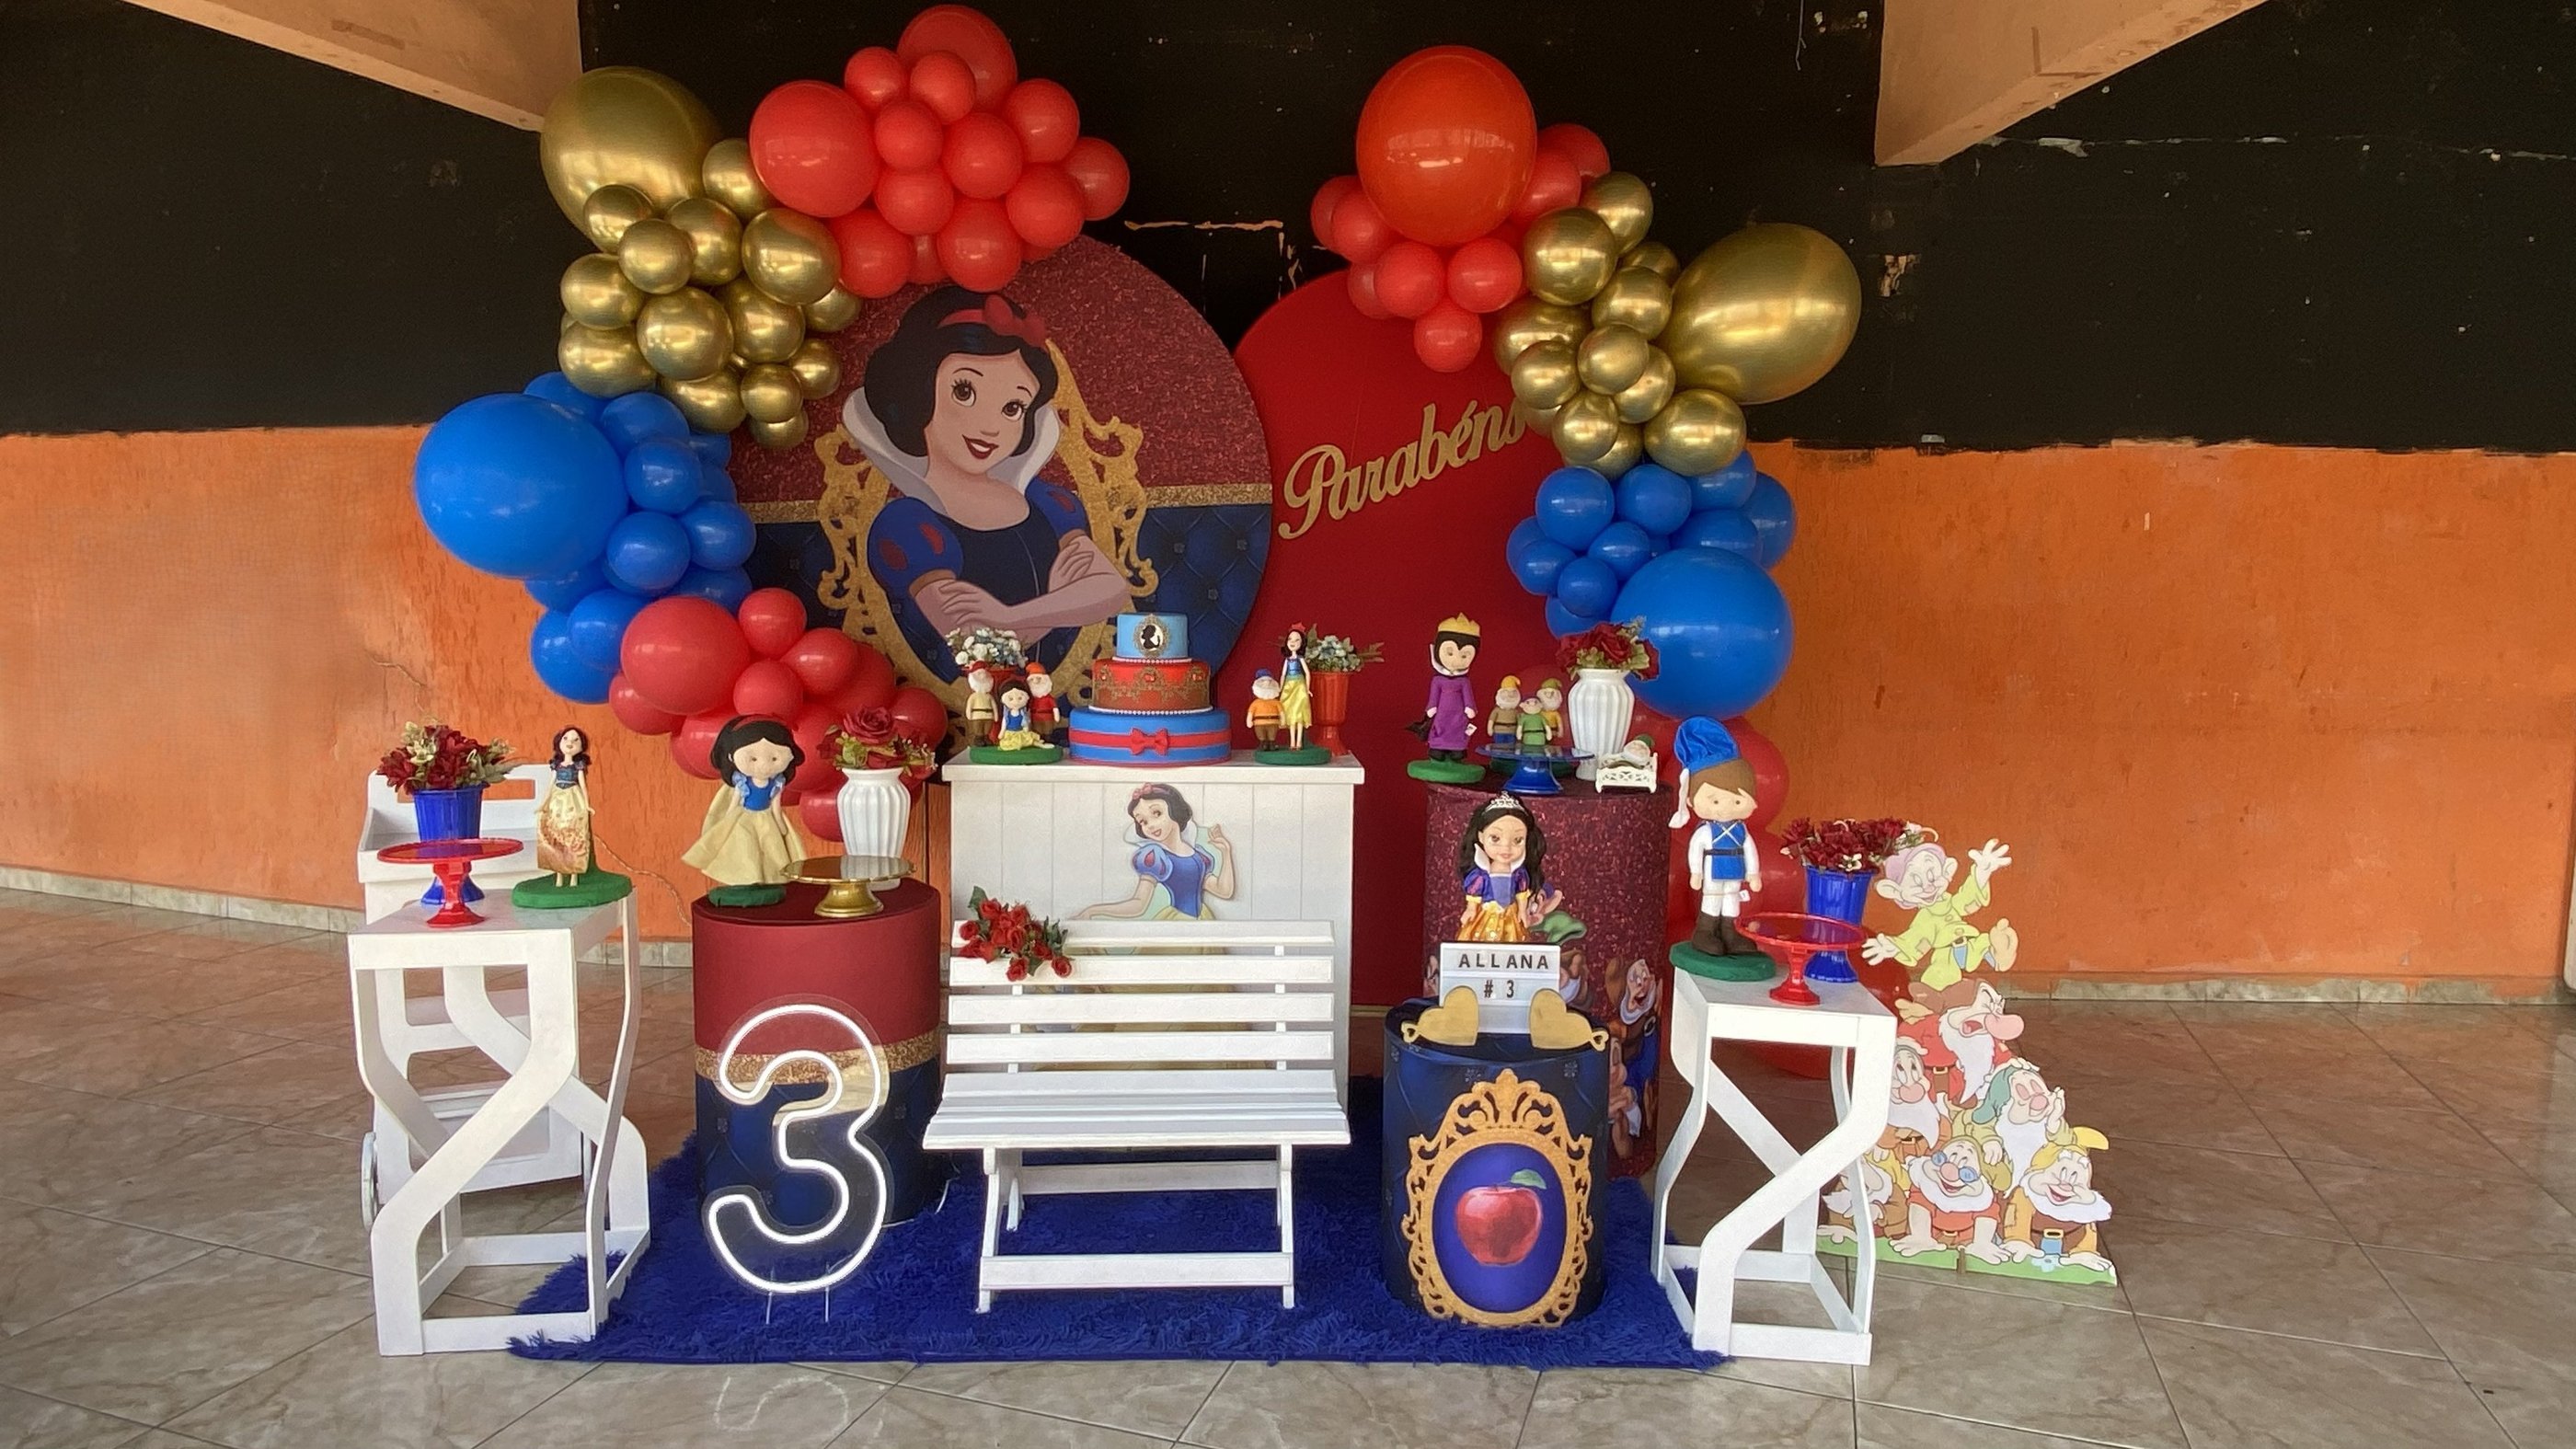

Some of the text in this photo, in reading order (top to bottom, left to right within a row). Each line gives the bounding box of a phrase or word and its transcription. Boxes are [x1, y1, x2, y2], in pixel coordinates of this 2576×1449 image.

[1279, 398, 1527, 539] Parabéns
[1459, 953, 1549, 970] ALLANA
[707, 1001, 889, 1293] 3
